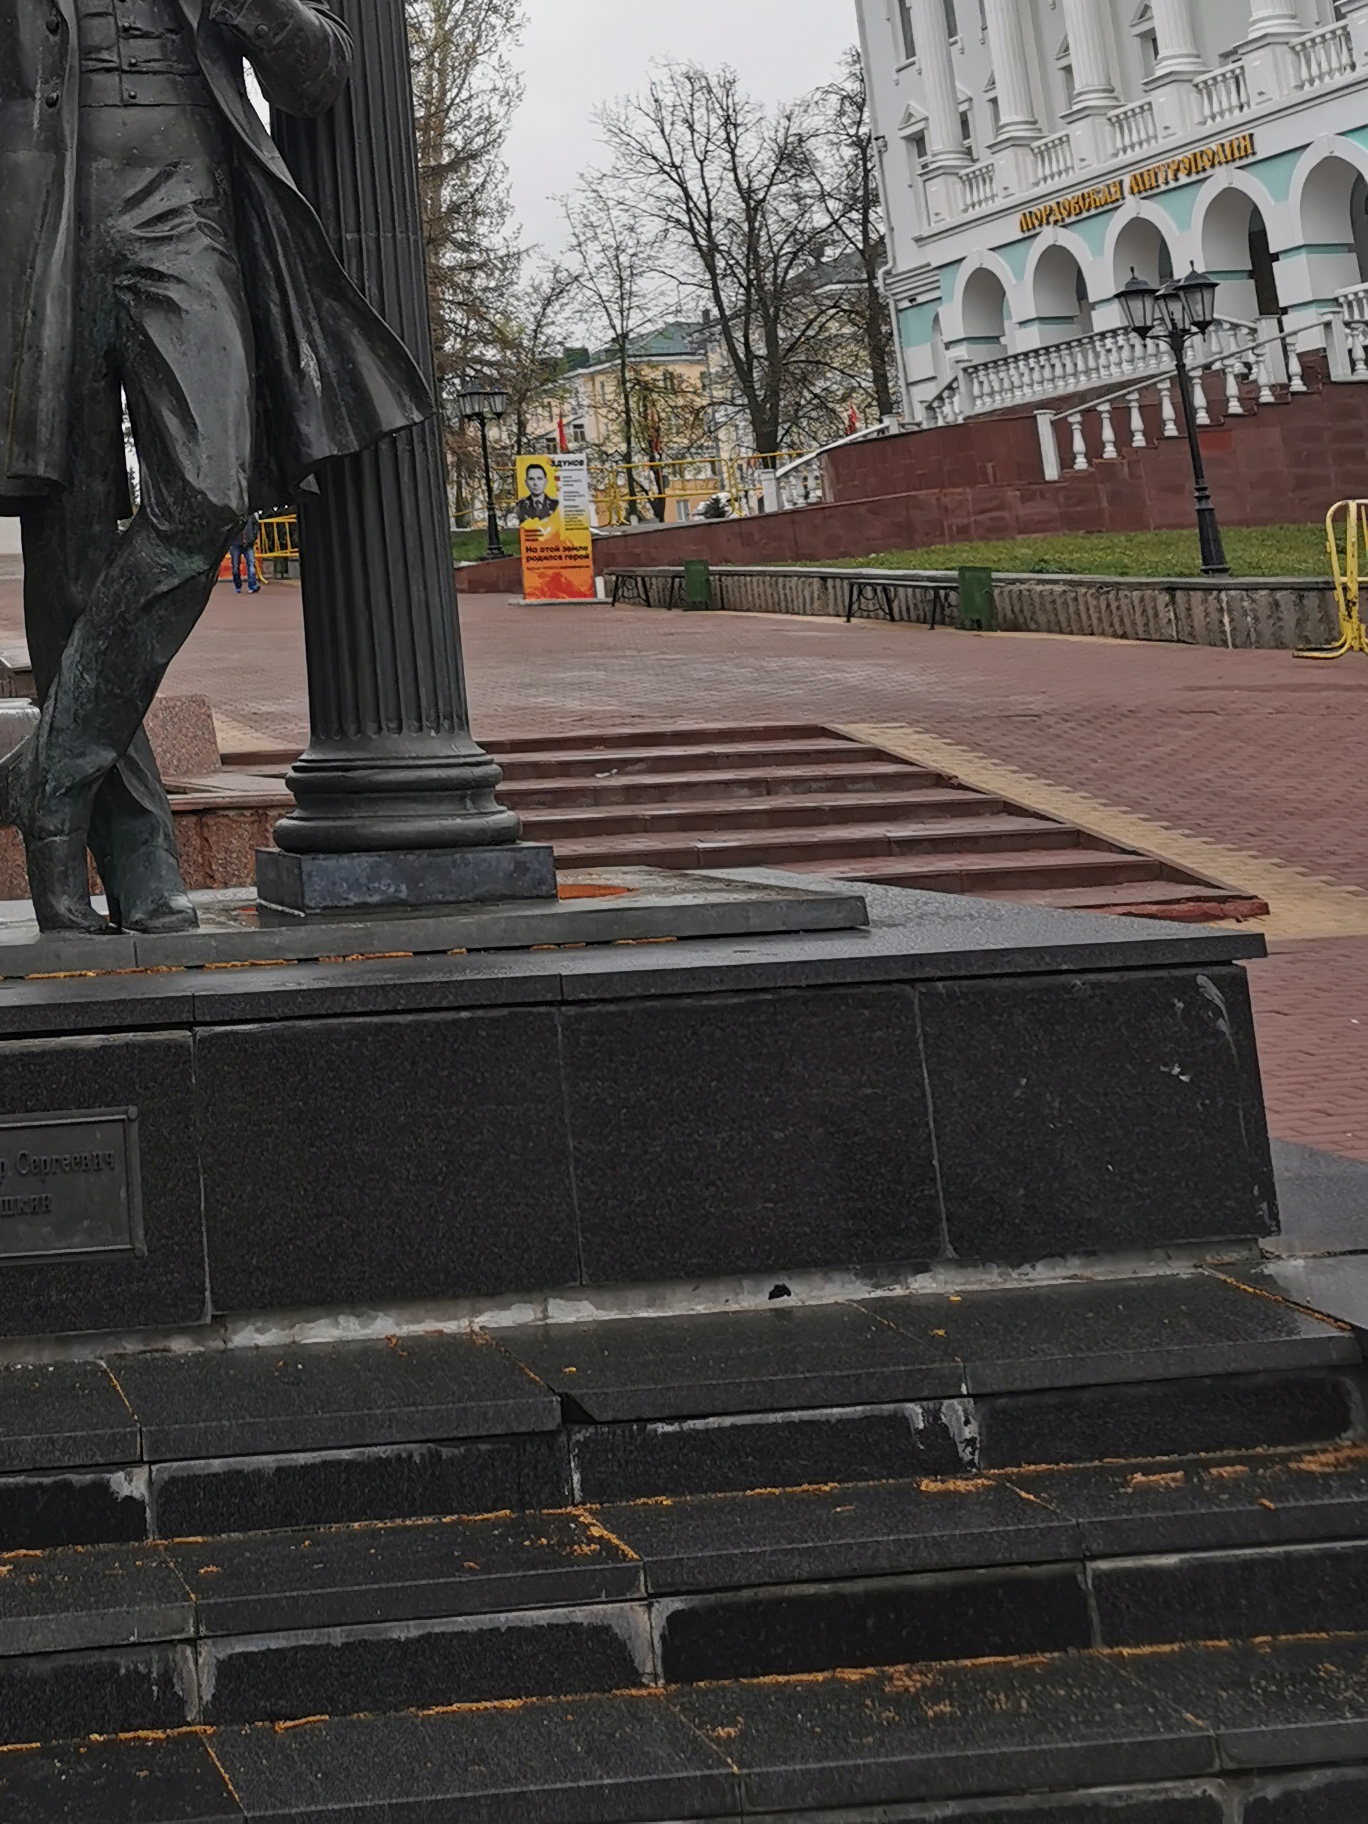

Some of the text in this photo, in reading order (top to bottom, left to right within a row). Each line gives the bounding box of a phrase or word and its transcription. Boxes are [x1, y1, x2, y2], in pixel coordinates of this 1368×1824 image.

[1019, 132, 1258, 233] МОРДОВСКАЯ МИТРОПОЛИЯ
[15, 1150, 116, 1184] Сергеевич
